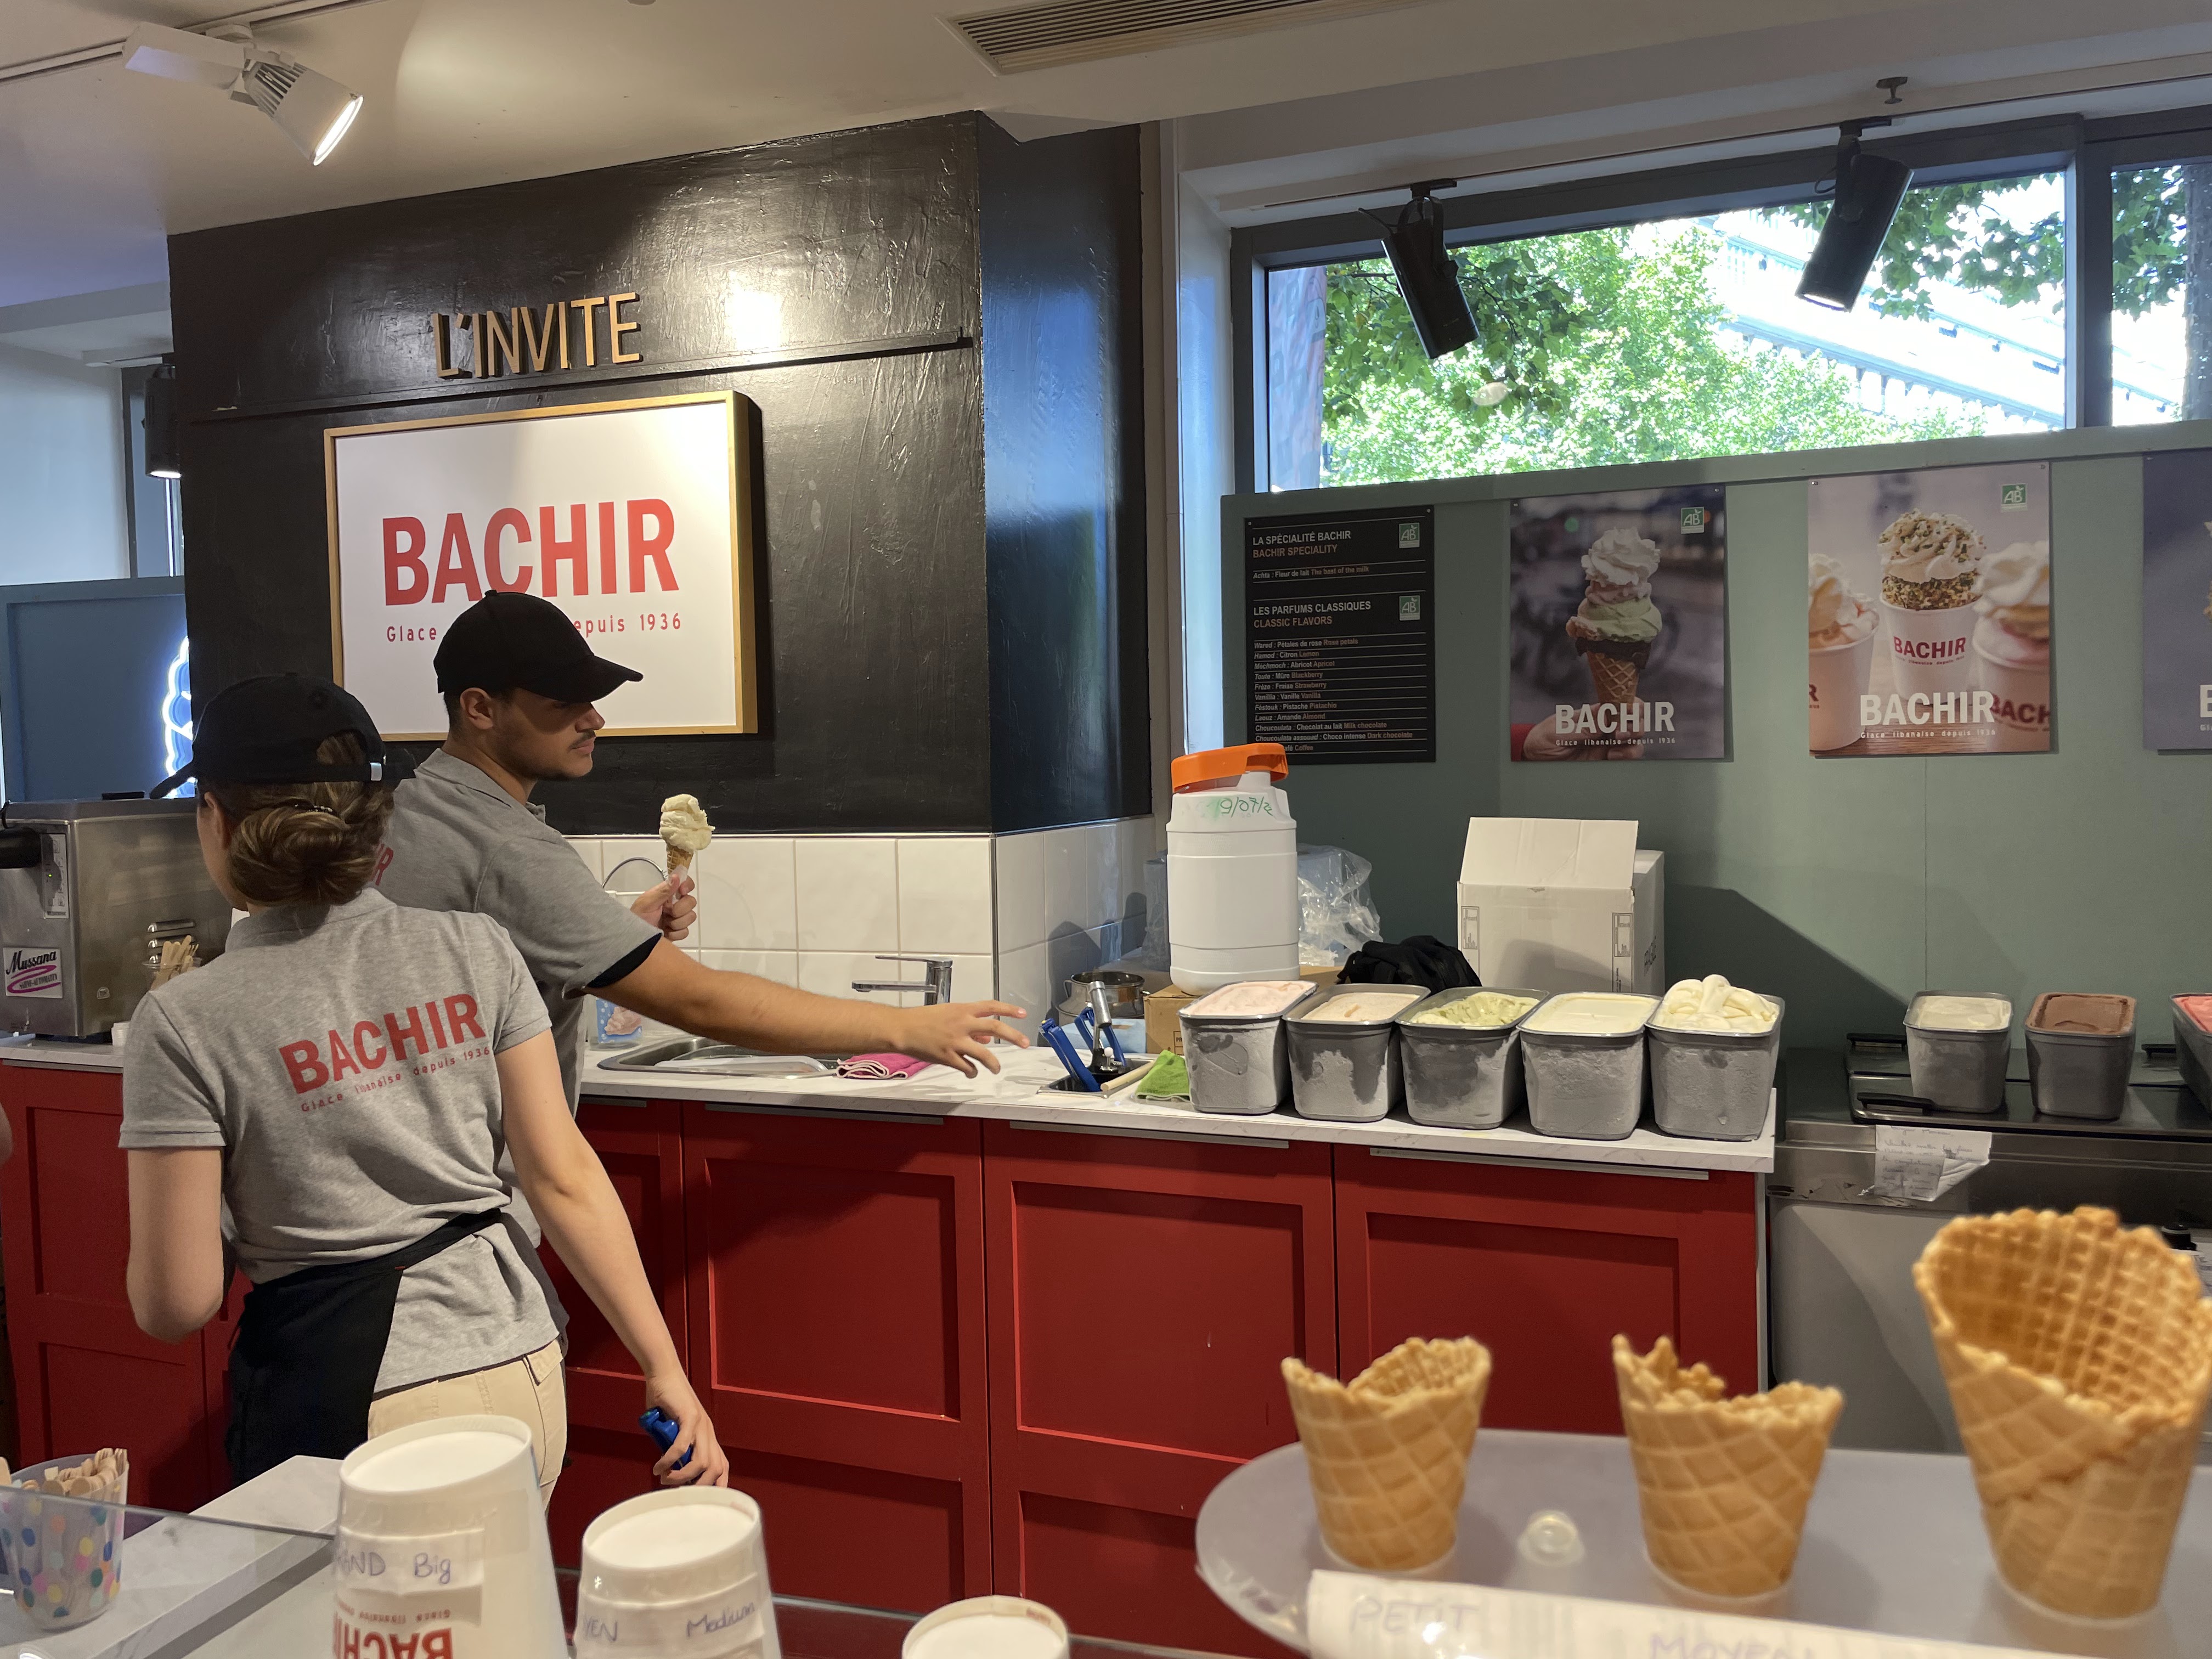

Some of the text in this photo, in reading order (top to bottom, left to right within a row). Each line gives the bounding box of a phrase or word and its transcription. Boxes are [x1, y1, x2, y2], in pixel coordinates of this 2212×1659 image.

[431, 292, 641, 379] L'INVITE
[2004, 490, 2022, 503] AB
[1683, 514, 1700, 526] AB
[1252, 531, 1351, 546] LA SPÉCIALITÉ BACHIR
[1401, 529, 1416, 540] AB
[382, 499, 680, 606] BACHIR
[1253, 544, 1338, 558] BACHIR SPECIALITY
[1254, 601, 1371, 616] LES PARFUMS CLASSIQUES
[1402, 602, 1417, 613] AB
[387, 612, 681, 642] Glace epuis 1936
[1254, 616, 1333, 629] CLASSIC FLAVORS
[1340, 638, 1358, 646] petals
[1893, 636, 1966, 658] BACHIR
[1555, 701, 1675, 734] BACHIR
[1860, 690, 1995, 726] BACHIR
[5, 950, 57, 975] Mussana
[279, 993, 486, 1094] BACHIR
[301, 1093, 343, 1112] Glace
[413, 1057, 456, 1076] depuis
[463, 1046, 490, 1061] 1936
[415, 1553, 451, 1579] Big
[686, 1601, 755, 1638] Medium
